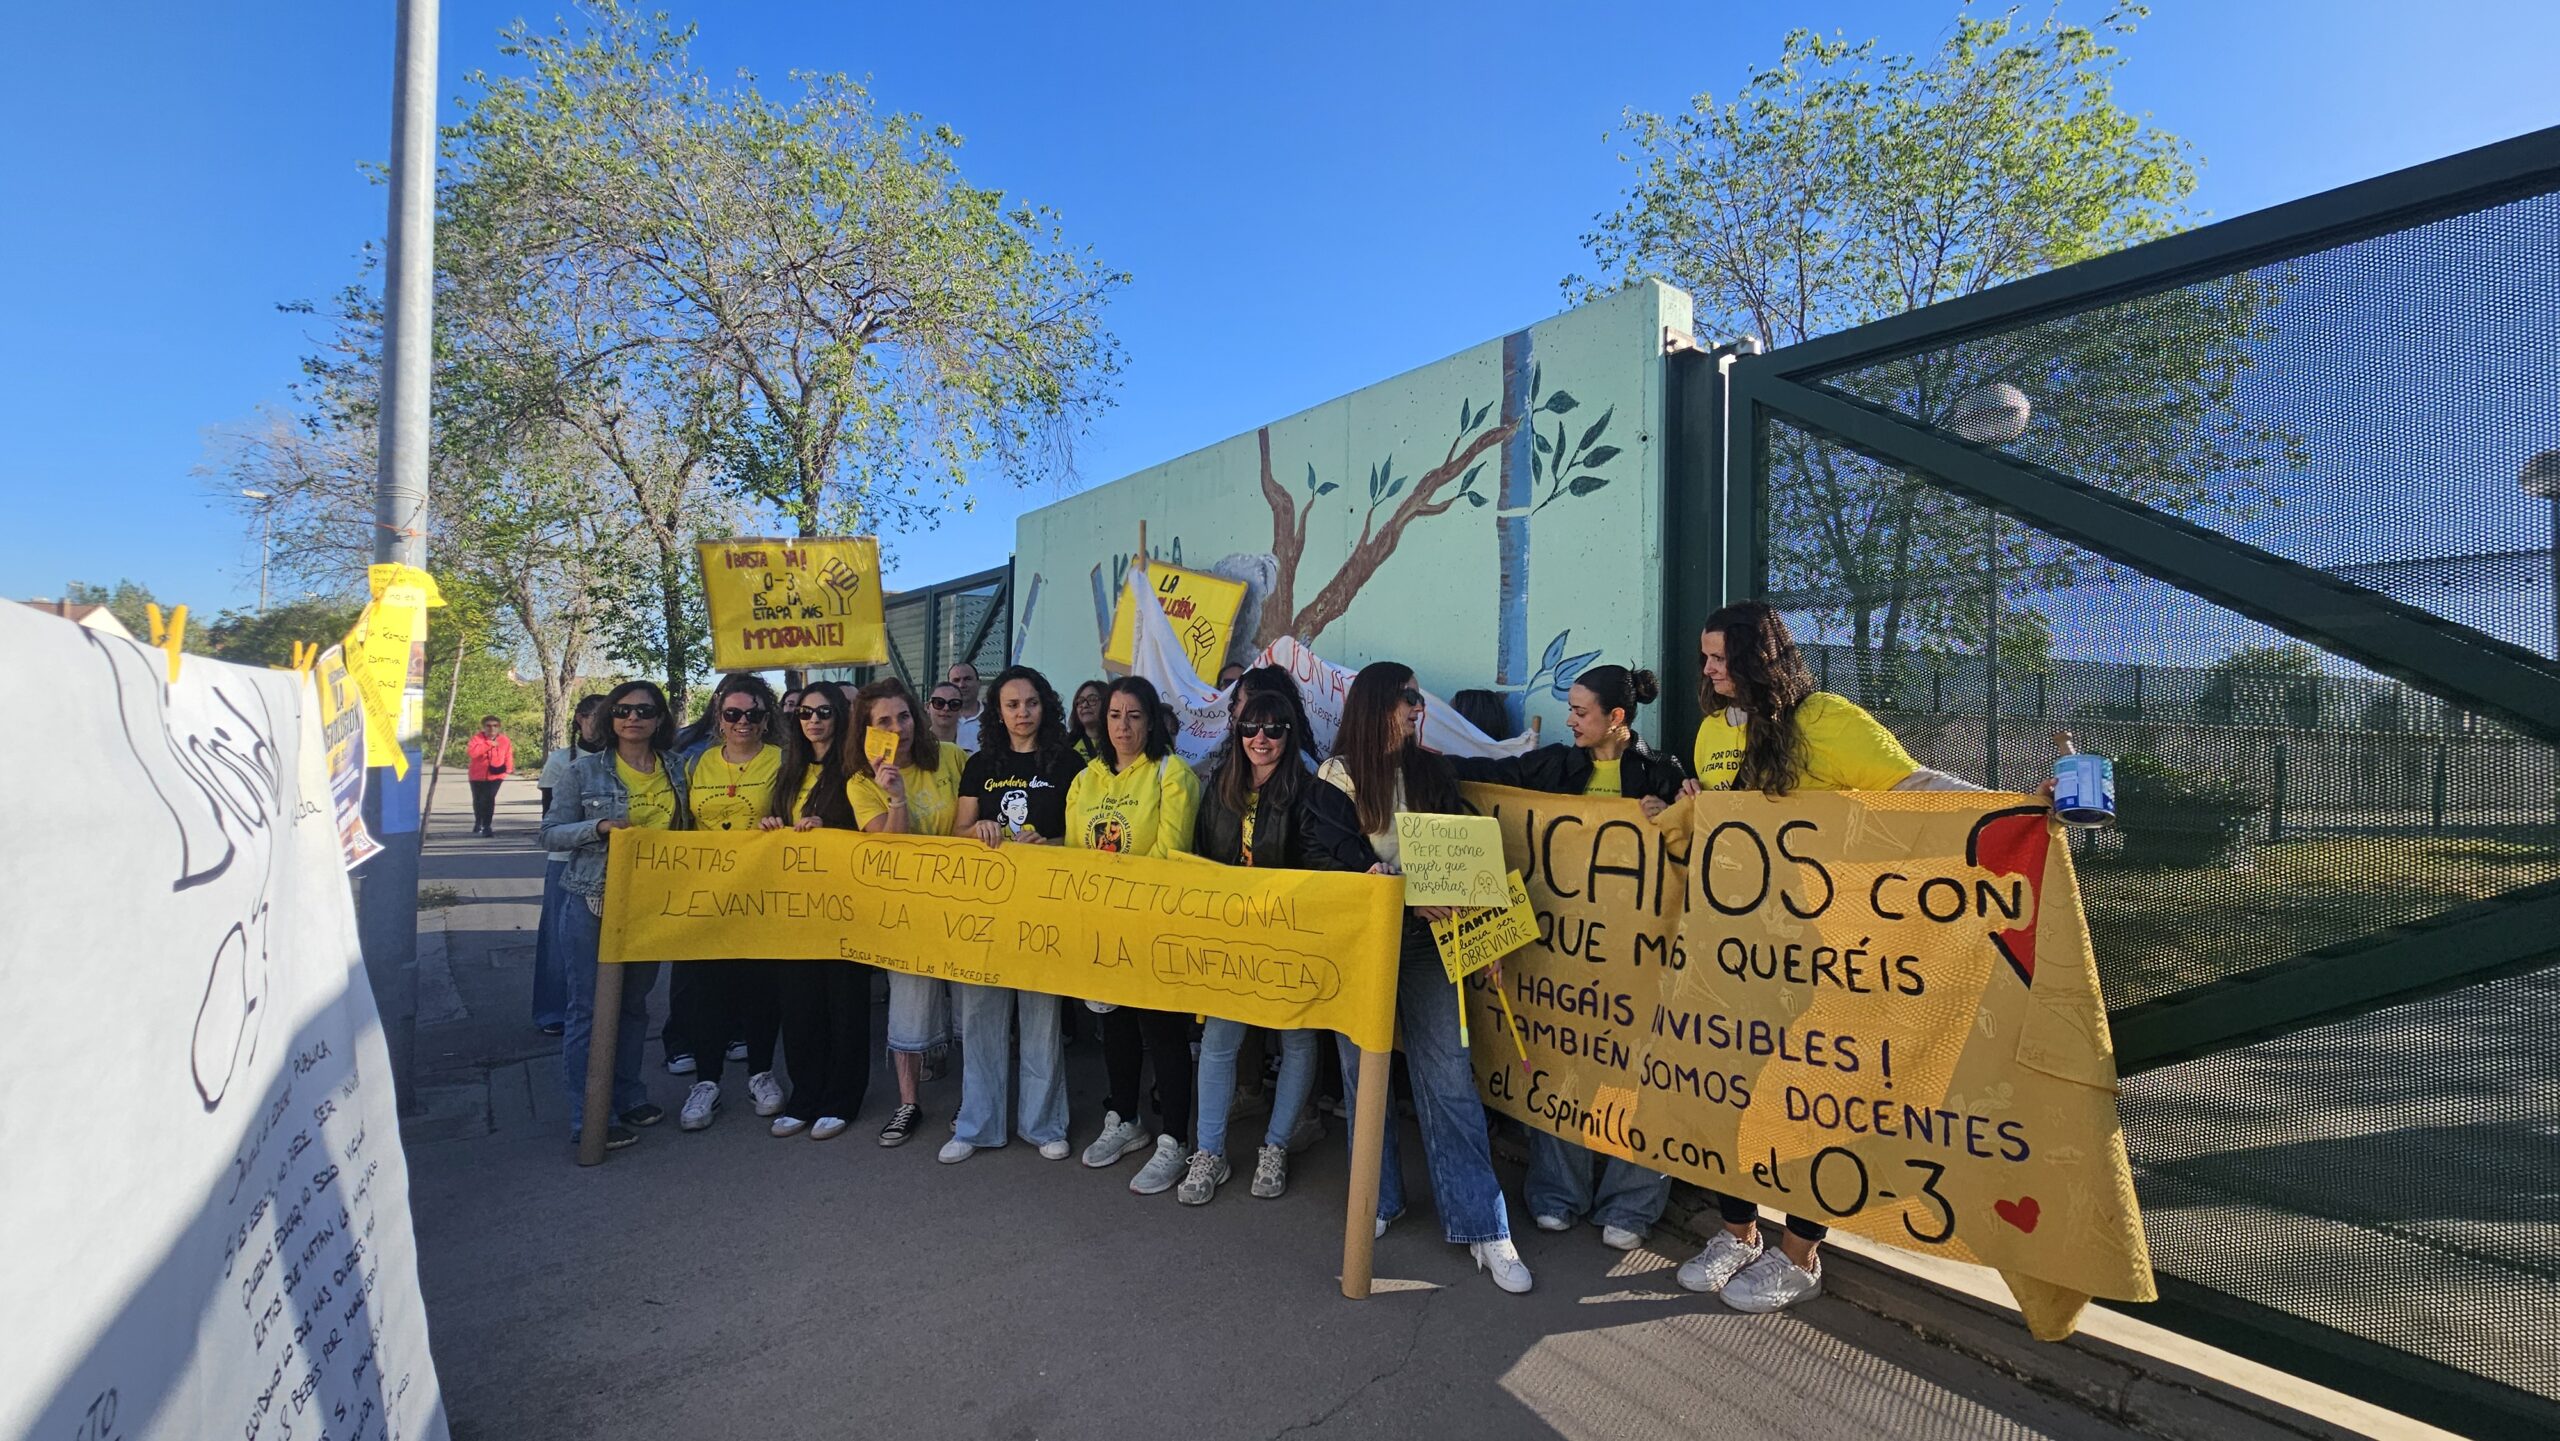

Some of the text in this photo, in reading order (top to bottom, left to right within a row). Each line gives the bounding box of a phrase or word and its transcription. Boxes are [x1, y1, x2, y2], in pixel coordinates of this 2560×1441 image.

[782, 549, 807, 571] YA!
[764, 573, 795, 591] 0-3
[1159, 574, 1179, 593] LA
[754, 592, 802, 606] ES LA
[753, 607, 792, 620] ETAPA
[1711, 751, 1724, 760] POR
[1402, 816, 1422, 838] El
[1447, 845, 1485, 857] come
[1404, 860, 1467, 880] mejor que
[635, 840, 1324, 935] HARTAS DEL MALTRATO INSTITUCIONAL
[1412, 875, 1468, 896] nosotras
[1511, 893, 1527, 908] NO
[1871, 872, 2022, 923] CON
[1497, 916, 1516, 930] ser
[660, 889, 1319, 990] LEVANTEMOS LA VOZ POR LA INFANCIA
[1536, 911, 1607, 963] QUE
[1717, 936, 1925, 996] QUERÉIS
[1518, 972, 1634, 1027] HAGÁIS
[1486, 1005, 2032, 1163] TAMBIÉN SOMOS DOCENTES
[1489, 1064, 1514, 1101] el
[1752, 1146, 1791, 1195] el
